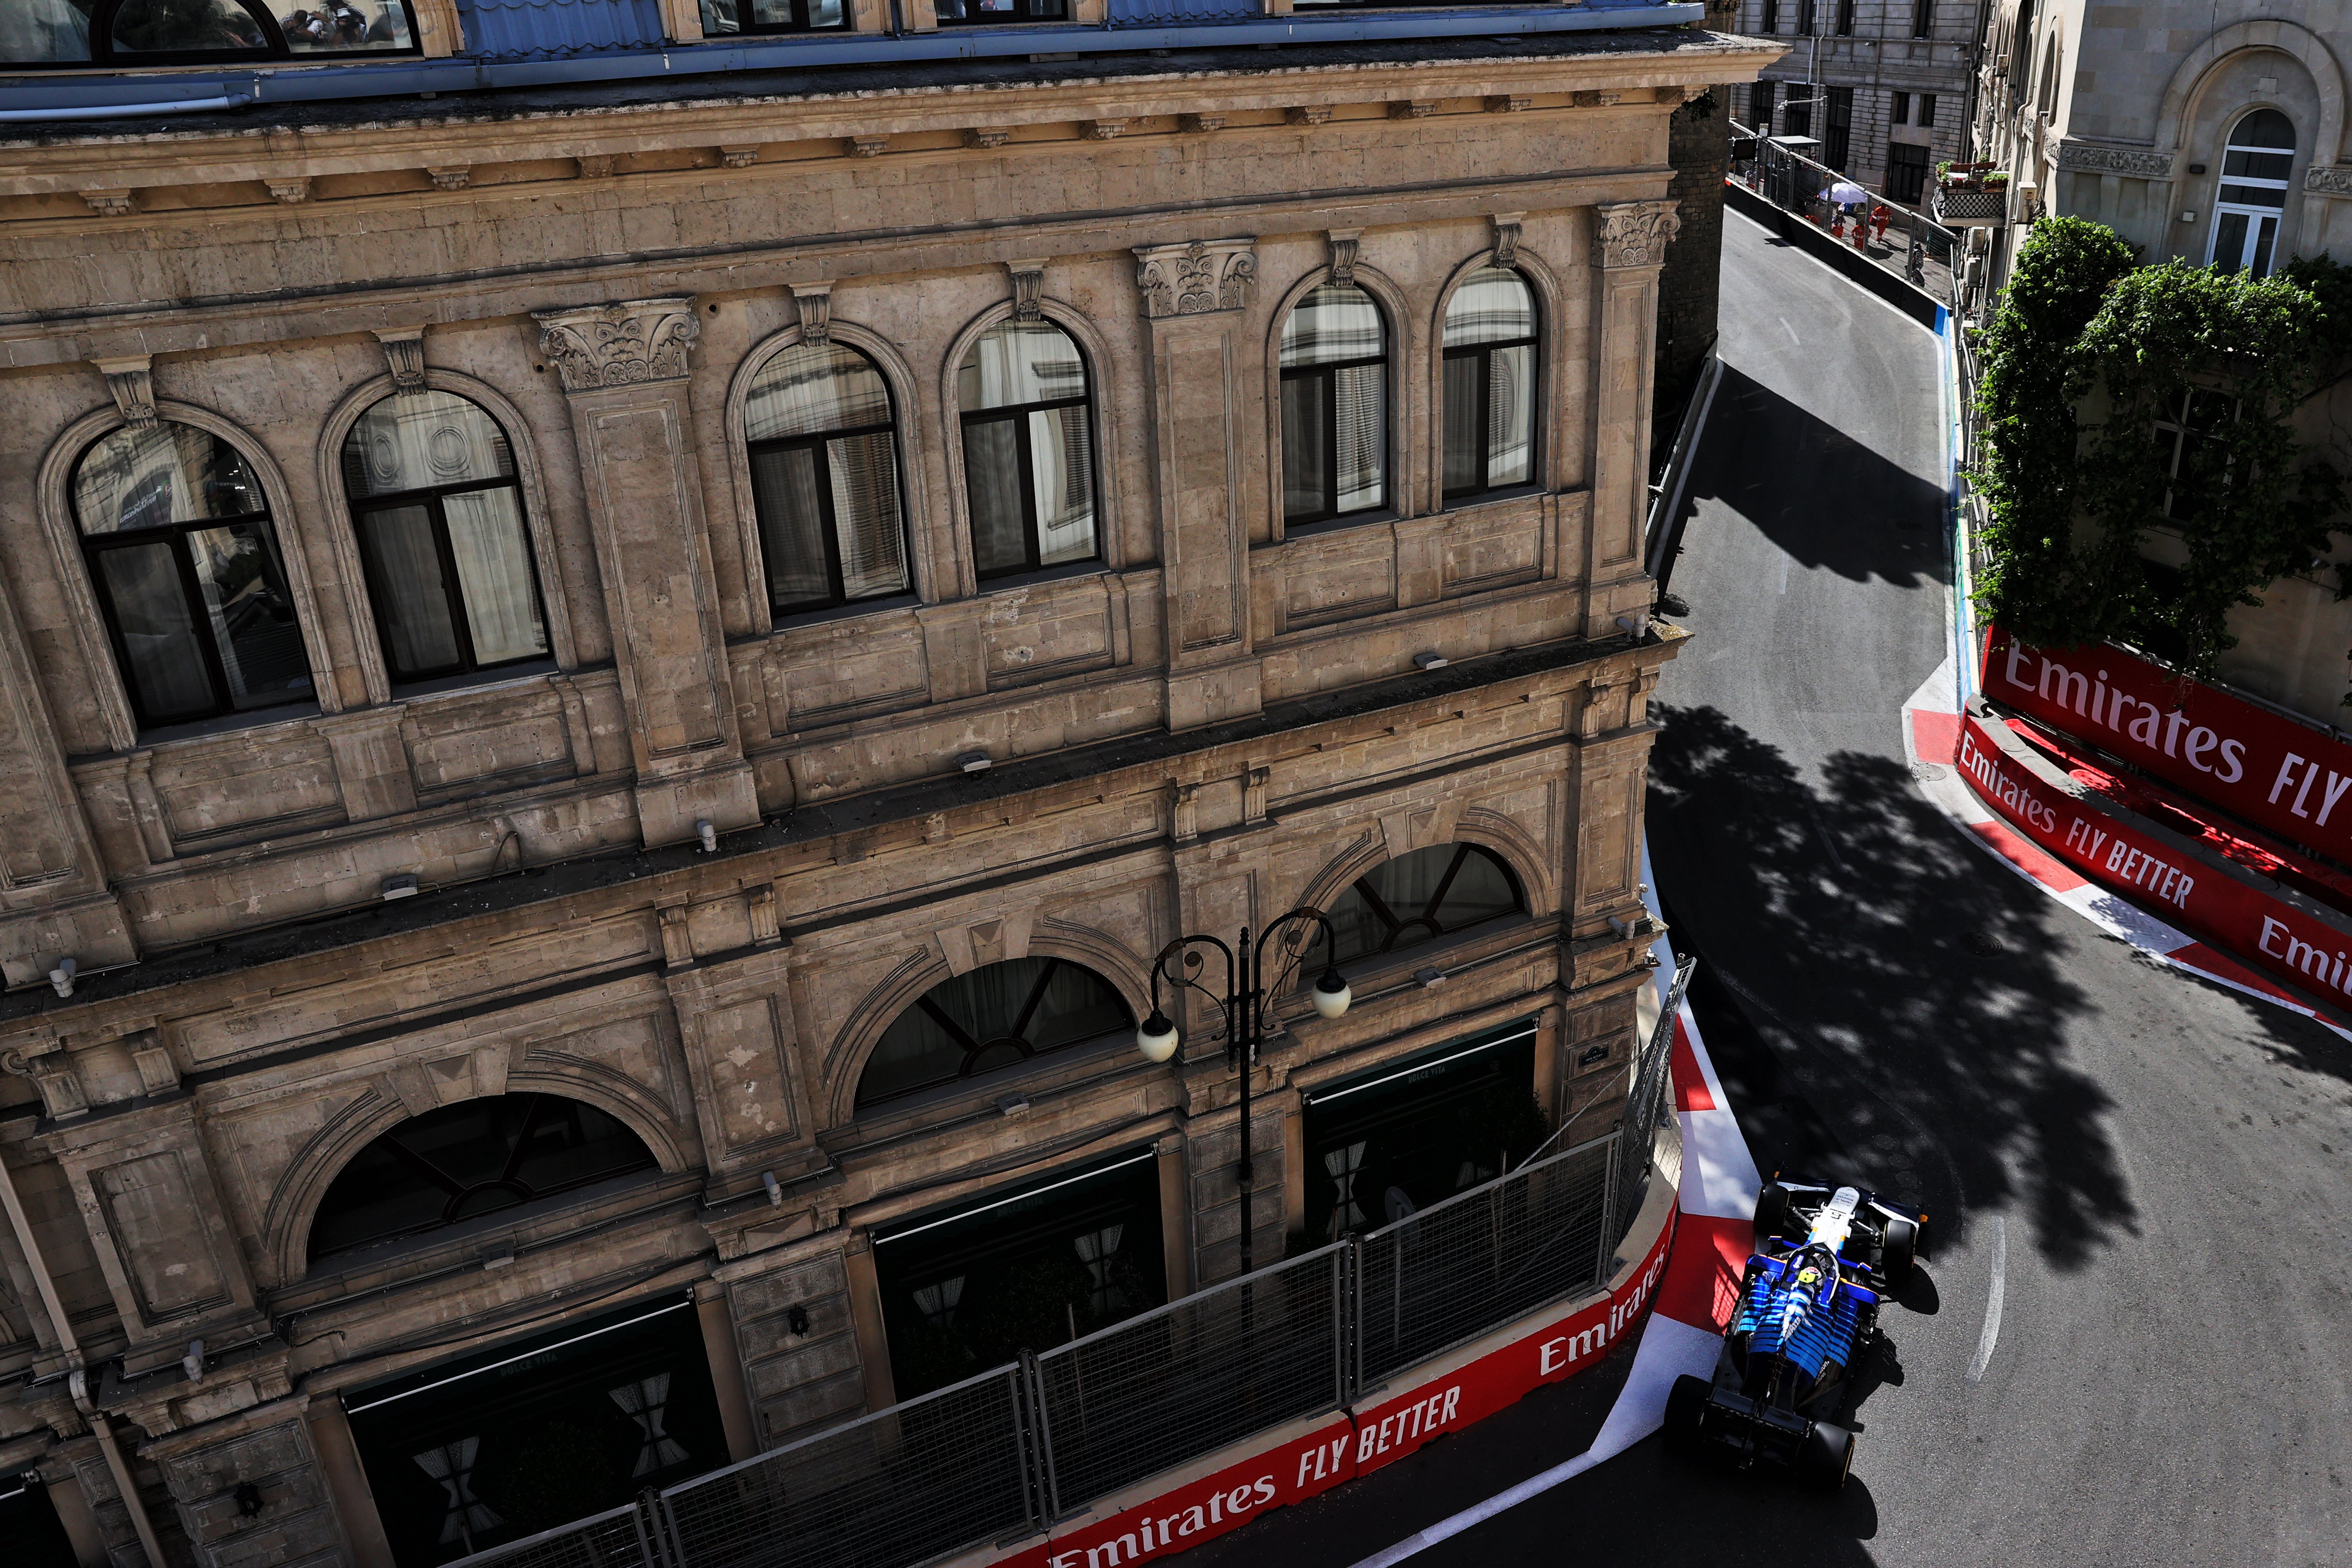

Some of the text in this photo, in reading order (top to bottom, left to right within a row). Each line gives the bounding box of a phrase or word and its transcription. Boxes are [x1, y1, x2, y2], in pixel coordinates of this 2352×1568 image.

[2006, 638, 2245, 783] Emirates
[2268, 752, 2352, 827] FLY
[1960, 730, 2194, 910] Emirates FLY BETTER
[1408, 1066, 1446, 1084] DOLCE VITA
[499, 1353, 557, 1378] DOLCE VITA
[1539, 1243, 1665, 1376] Emirates
[1297, 1435, 1349, 1488] FLY
[1357, 1385, 1461, 1463] BETTER
